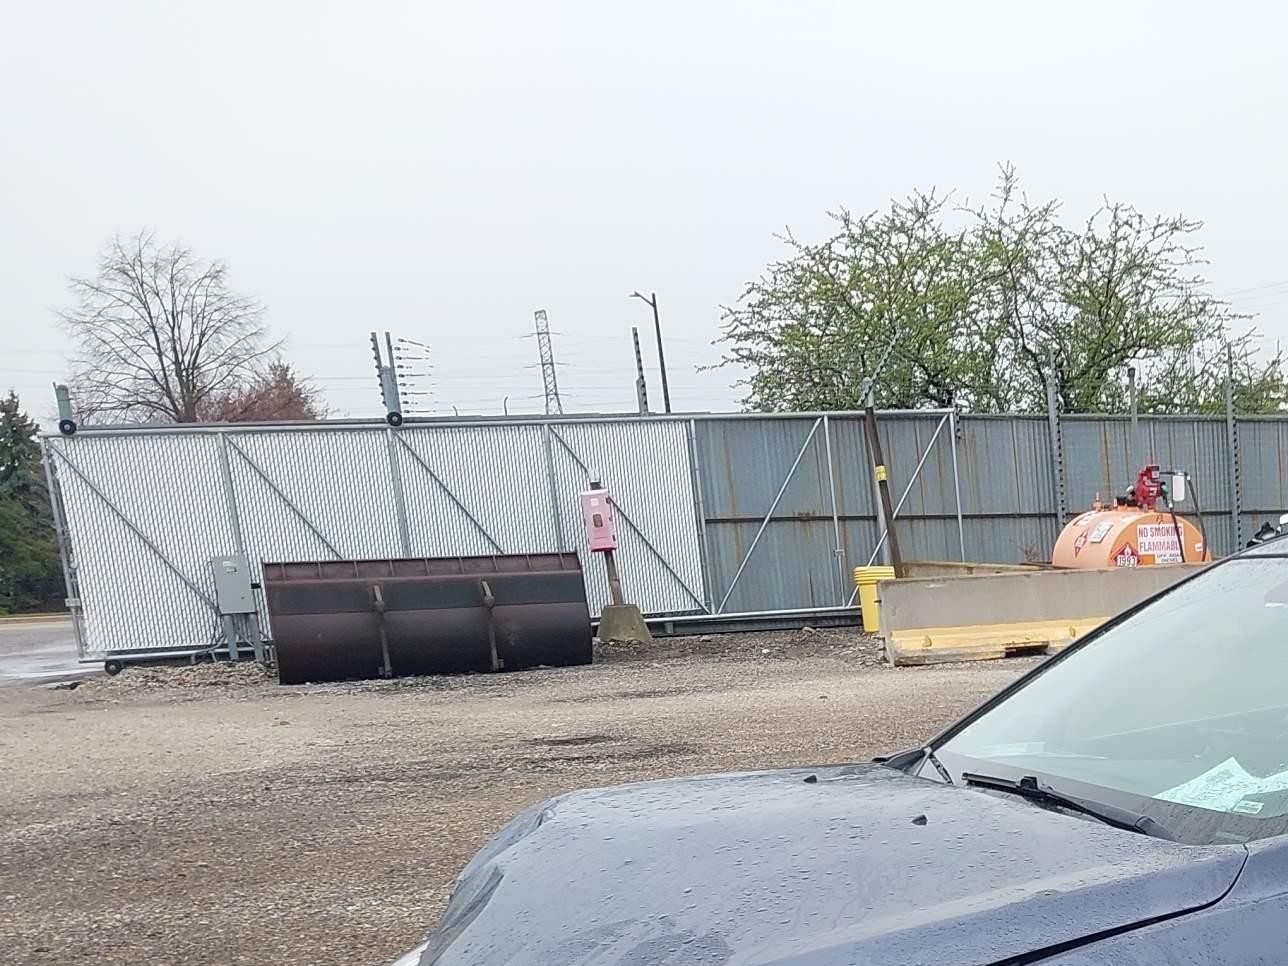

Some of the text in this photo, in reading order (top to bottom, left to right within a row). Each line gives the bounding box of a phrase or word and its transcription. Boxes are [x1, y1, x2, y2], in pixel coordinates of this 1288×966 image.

[1139, 527, 1148, 538] NO
[1140, 540, 1180, 552] FLAMMABL
[1119, 556, 1136, 567] 1993
